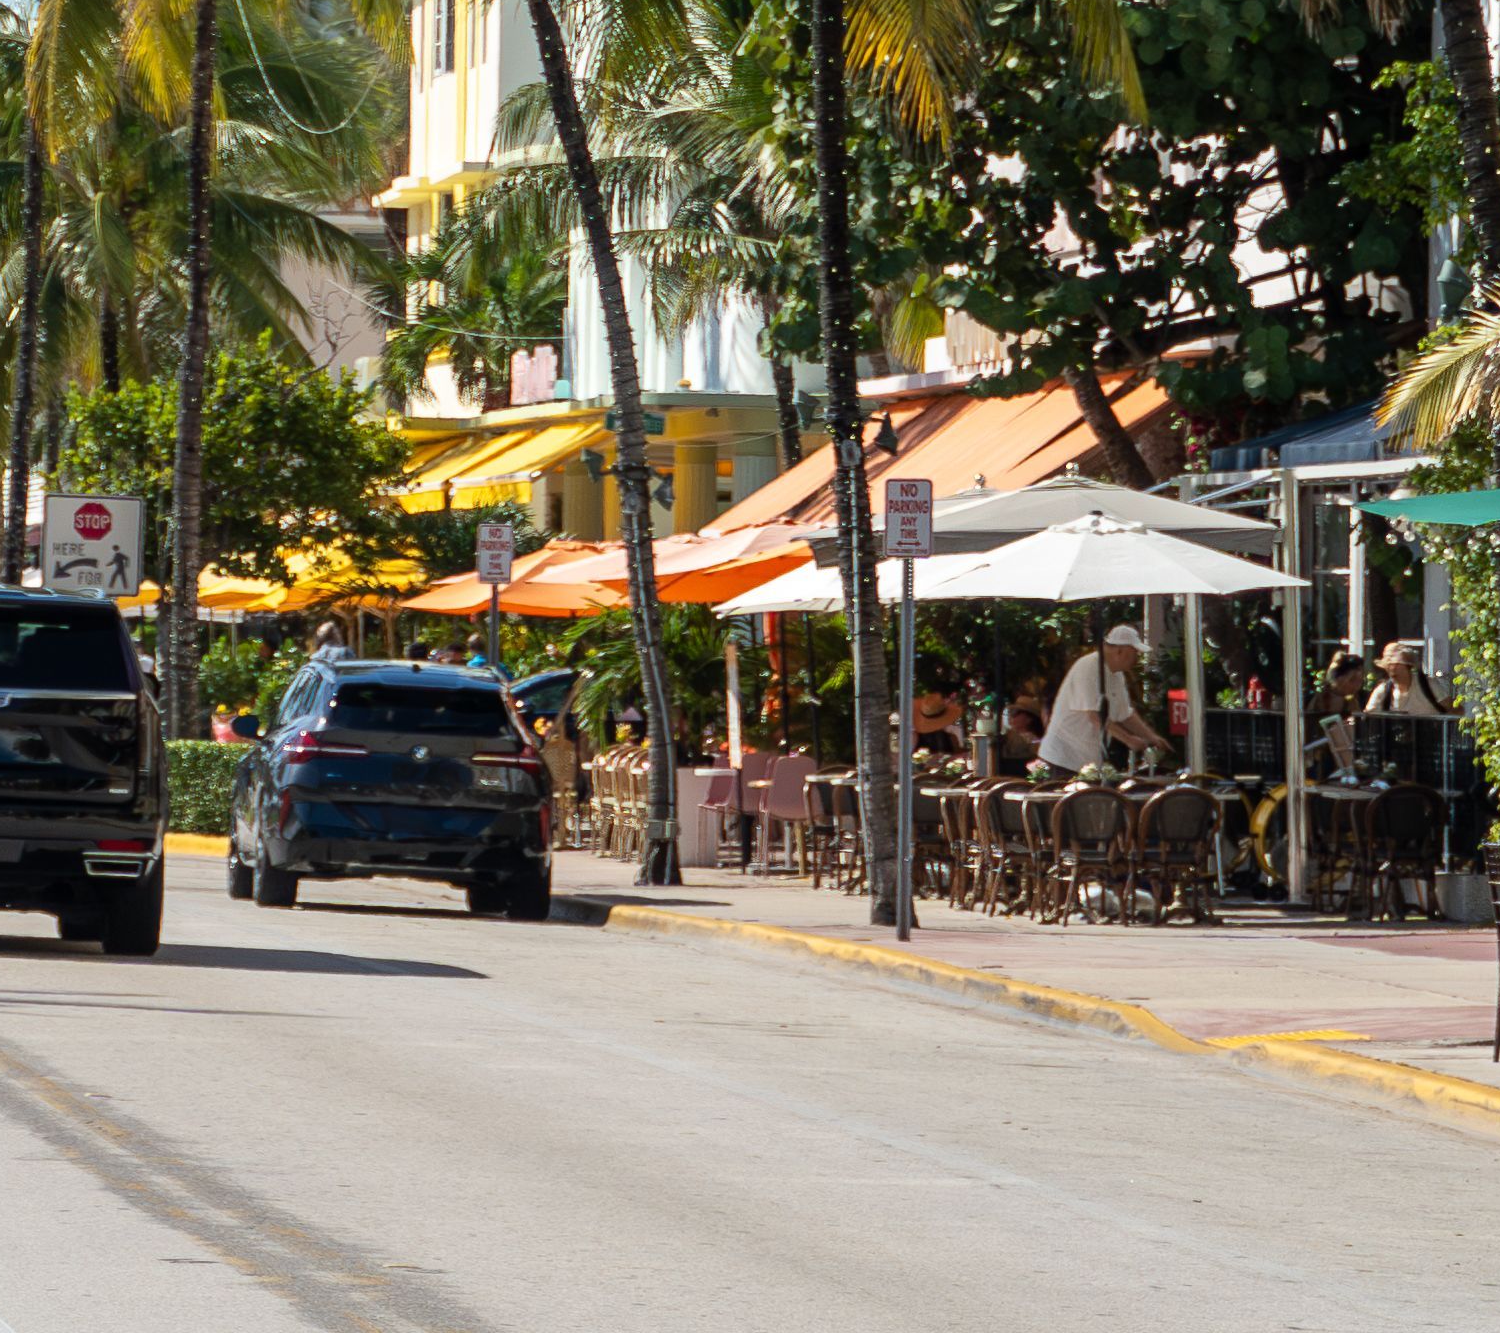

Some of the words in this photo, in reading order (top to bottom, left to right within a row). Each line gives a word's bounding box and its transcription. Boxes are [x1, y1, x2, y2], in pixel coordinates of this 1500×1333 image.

[901, 483, 918, 497] NO
[889, 499, 929, 513] PARKING
[75, 514, 110, 529] STOP
[902, 516, 917, 526] ANY
[53, 543, 85, 556] HERE
[78, 572, 102, 585] FOR
